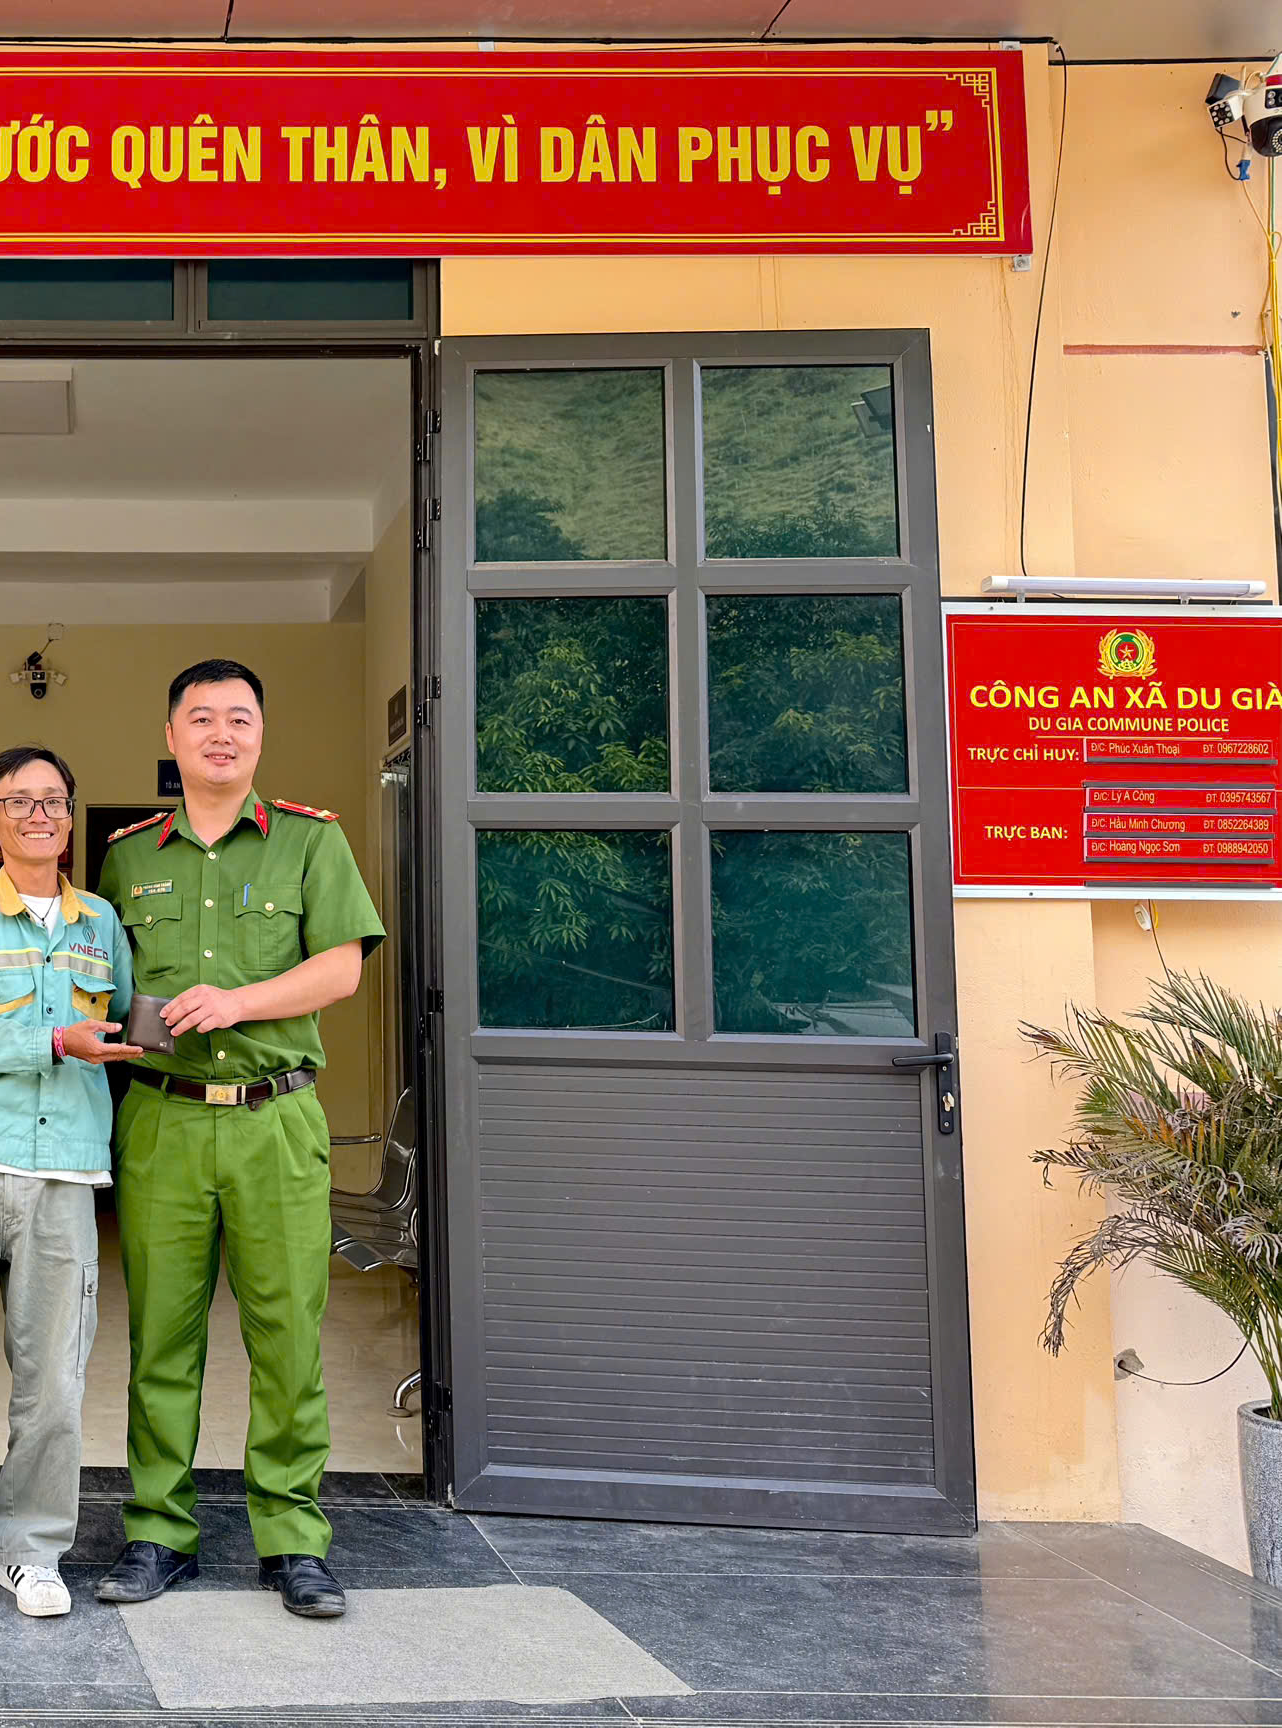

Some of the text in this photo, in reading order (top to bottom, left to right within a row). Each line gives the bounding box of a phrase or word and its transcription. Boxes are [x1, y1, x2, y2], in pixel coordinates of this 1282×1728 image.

[112, 113, 261, 189] QUÊN
[281, 114, 447, 190] THÂN,
[467, 115, 518, 183] VÌ
[541, 114, 657, 183] DÂN
[679, 125, 830, 195] PHỤC
[969, 679, 1282, 711] CÔNG AN XÃ DU GIÀ
[1029, 717, 1229, 732] DU GIA COMMUNE POLICE
[967, 743, 1079, 763] TRỰC CHỈ HUY:
[1109, 743, 1131, 754] Phúc
[1132, 743, 1154, 754] Xuân
[1155, 743, 1180, 757] Thoại
[1217, 743, 1269, 754] 0967228602
[1111, 790, 1122, 804] Lý
[1124, 791, 1130, 801] A
[1220, 792, 1272, 804] 0395743567
[1129, 818, 1148, 829] Minh
[1151, 818, 1186, 833] Chương
[1217, 819, 1269, 831] 0852264389
[984, 825, 1068, 841] TRỰC BAN:
[1110, 841, 1136, 854] Hoàng
[1138, 841, 1161, 854] Ngọc
[1163, 841, 1180, 852] Sơn
[1217, 842, 1269, 854] 0988942050
[69, 942, 109, 960] VNECO
